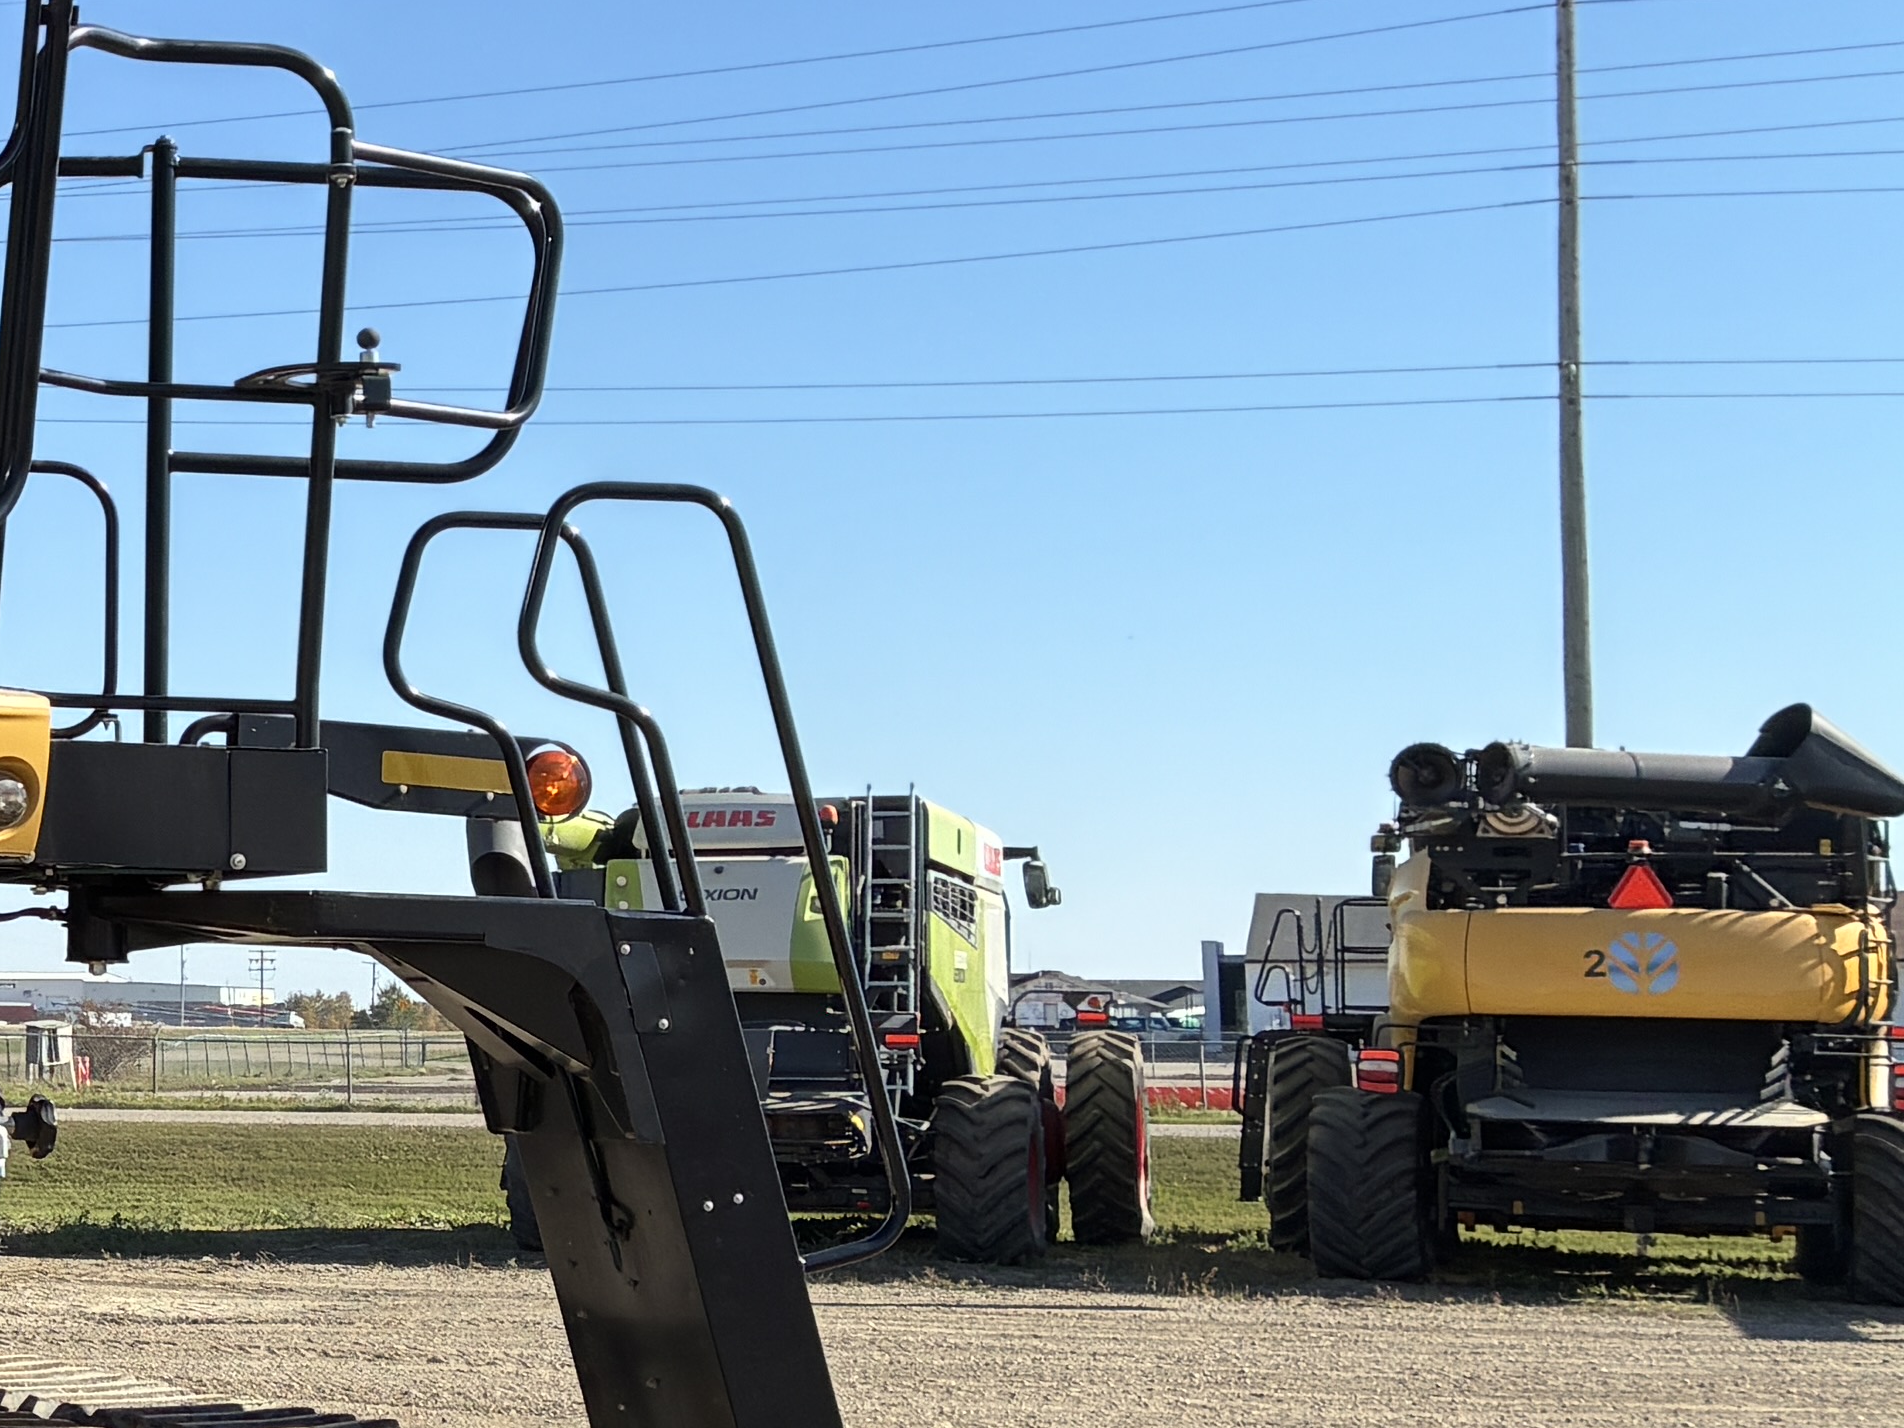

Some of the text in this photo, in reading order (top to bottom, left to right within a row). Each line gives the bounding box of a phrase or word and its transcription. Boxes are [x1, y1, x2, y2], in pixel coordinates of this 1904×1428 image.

[684, 810, 777, 828] LAAS
[679, 887, 759, 901] XION
[1583, 949, 1607, 978] 2
